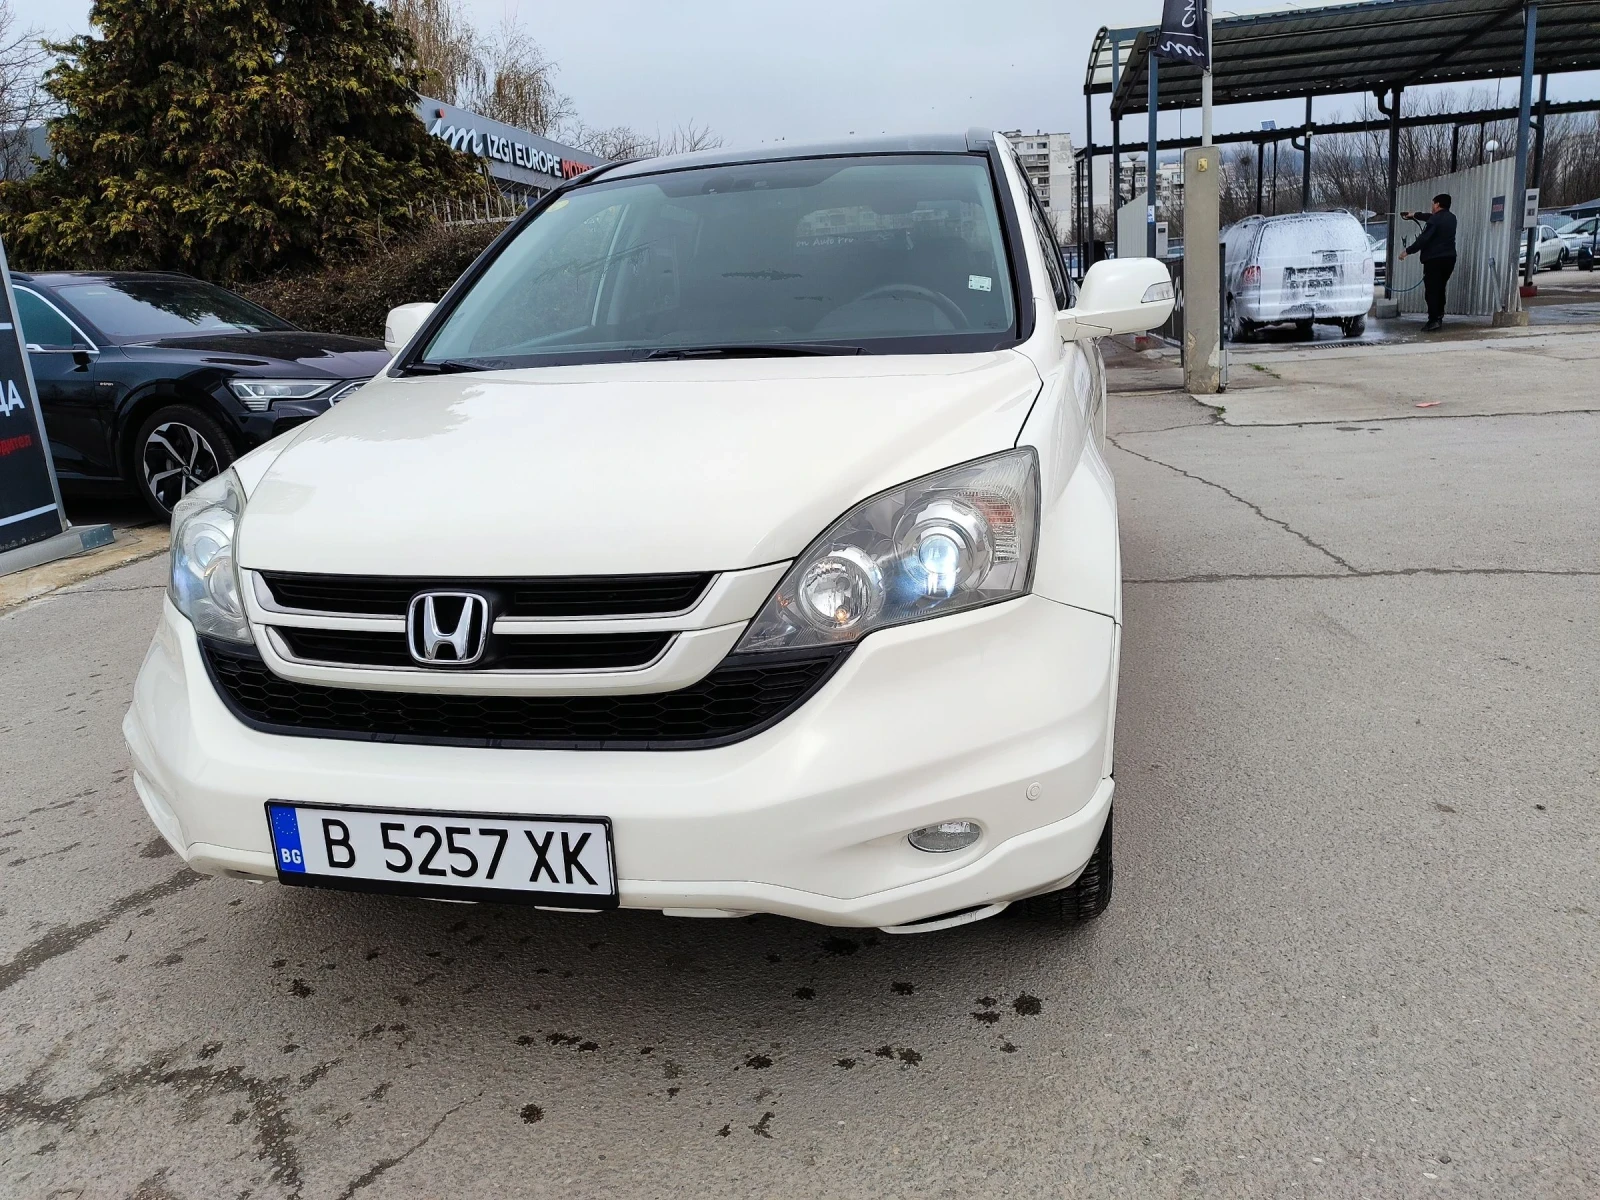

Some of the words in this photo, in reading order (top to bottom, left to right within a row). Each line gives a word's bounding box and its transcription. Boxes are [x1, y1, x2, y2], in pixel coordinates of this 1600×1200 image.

[487, 133, 514, 163] IZGI
[514, 142, 562, 177] EUROPE
[281, 847, 302, 865] BG
[321, 818, 357, 869] B
[380, 821, 509, 881] 5257
[523, 829, 599, 886] XK
